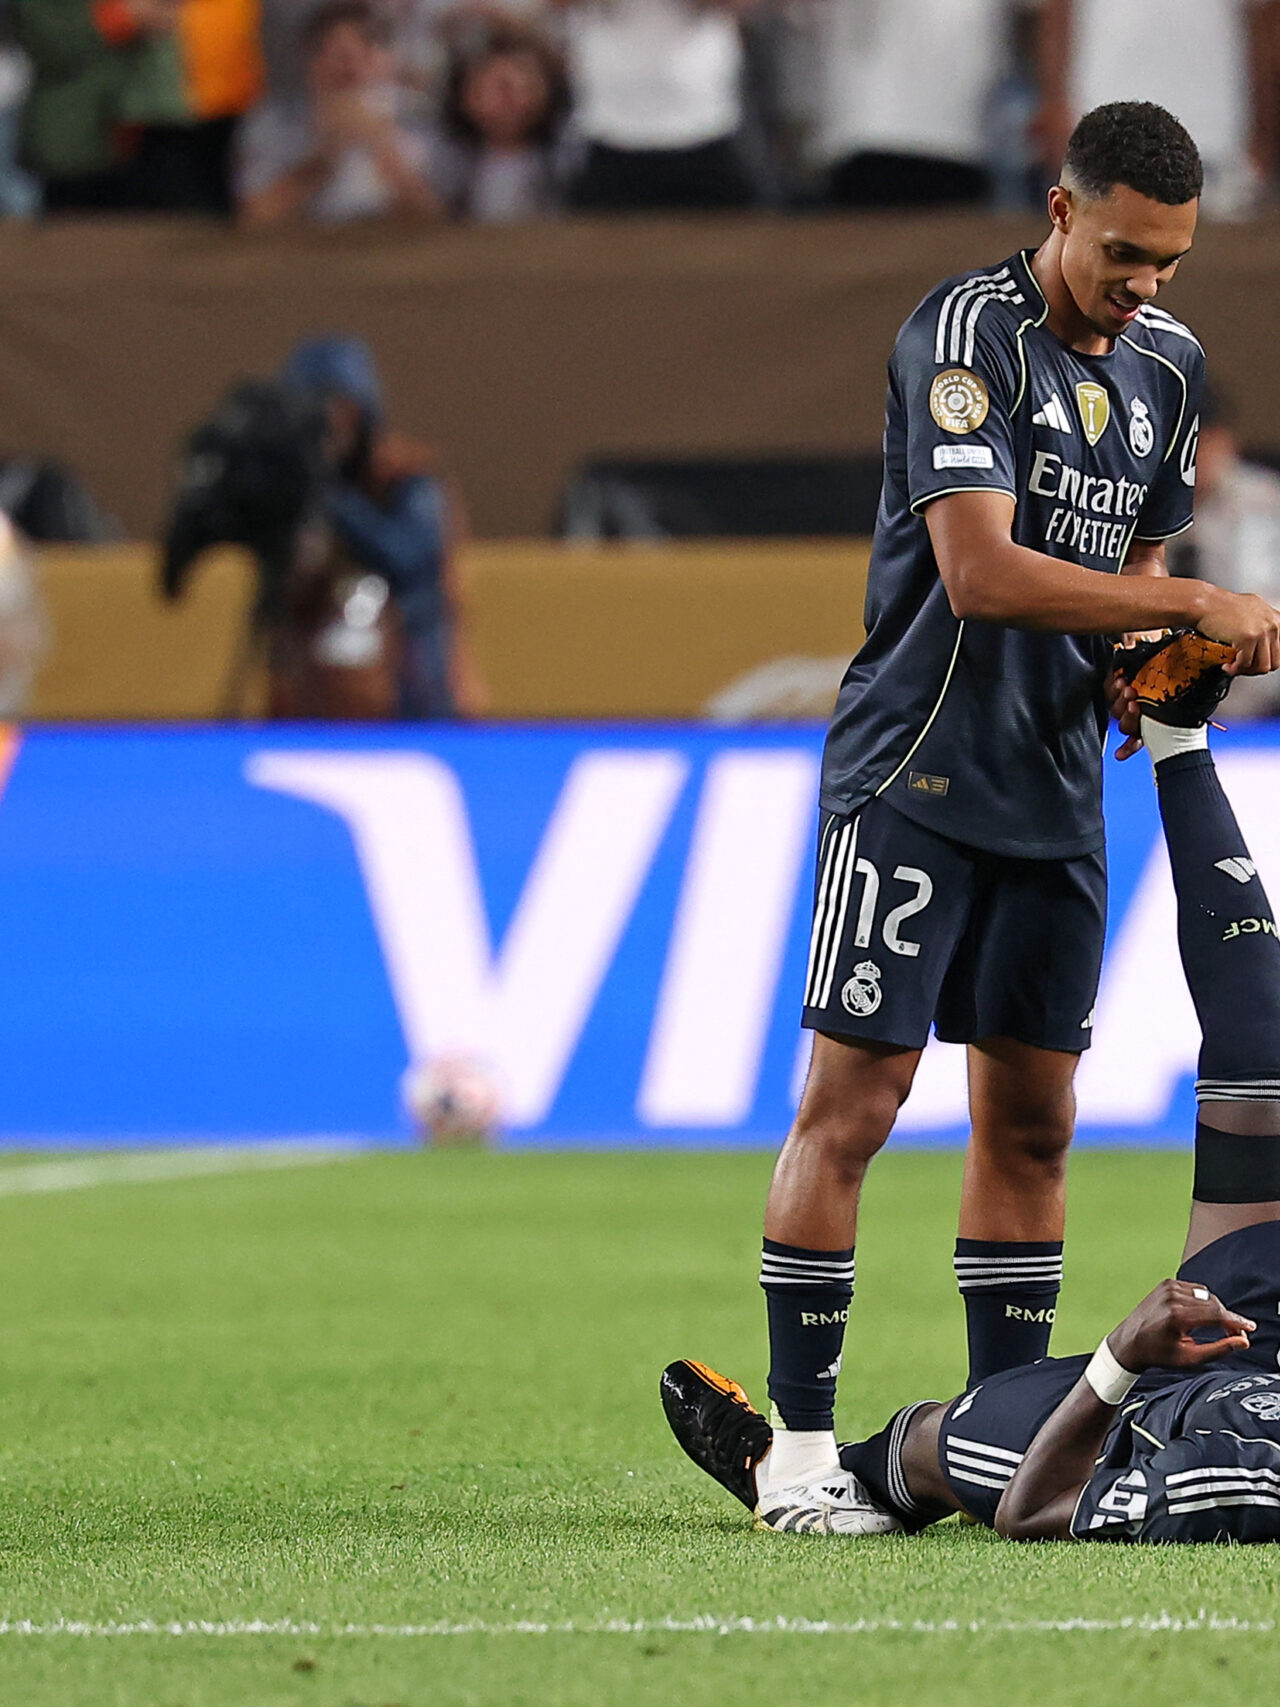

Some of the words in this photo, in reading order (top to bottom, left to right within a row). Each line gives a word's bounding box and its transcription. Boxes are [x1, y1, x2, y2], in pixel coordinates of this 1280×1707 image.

[934, 375, 960, 394] WORLD
[961, 376, 978, 389] CUP
[945, 418, 969, 428] FIFA
[1028, 450, 1148, 517] Emrates
[1078, 518, 1127, 558] ETTE
[854, 857, 933, 957] 12
